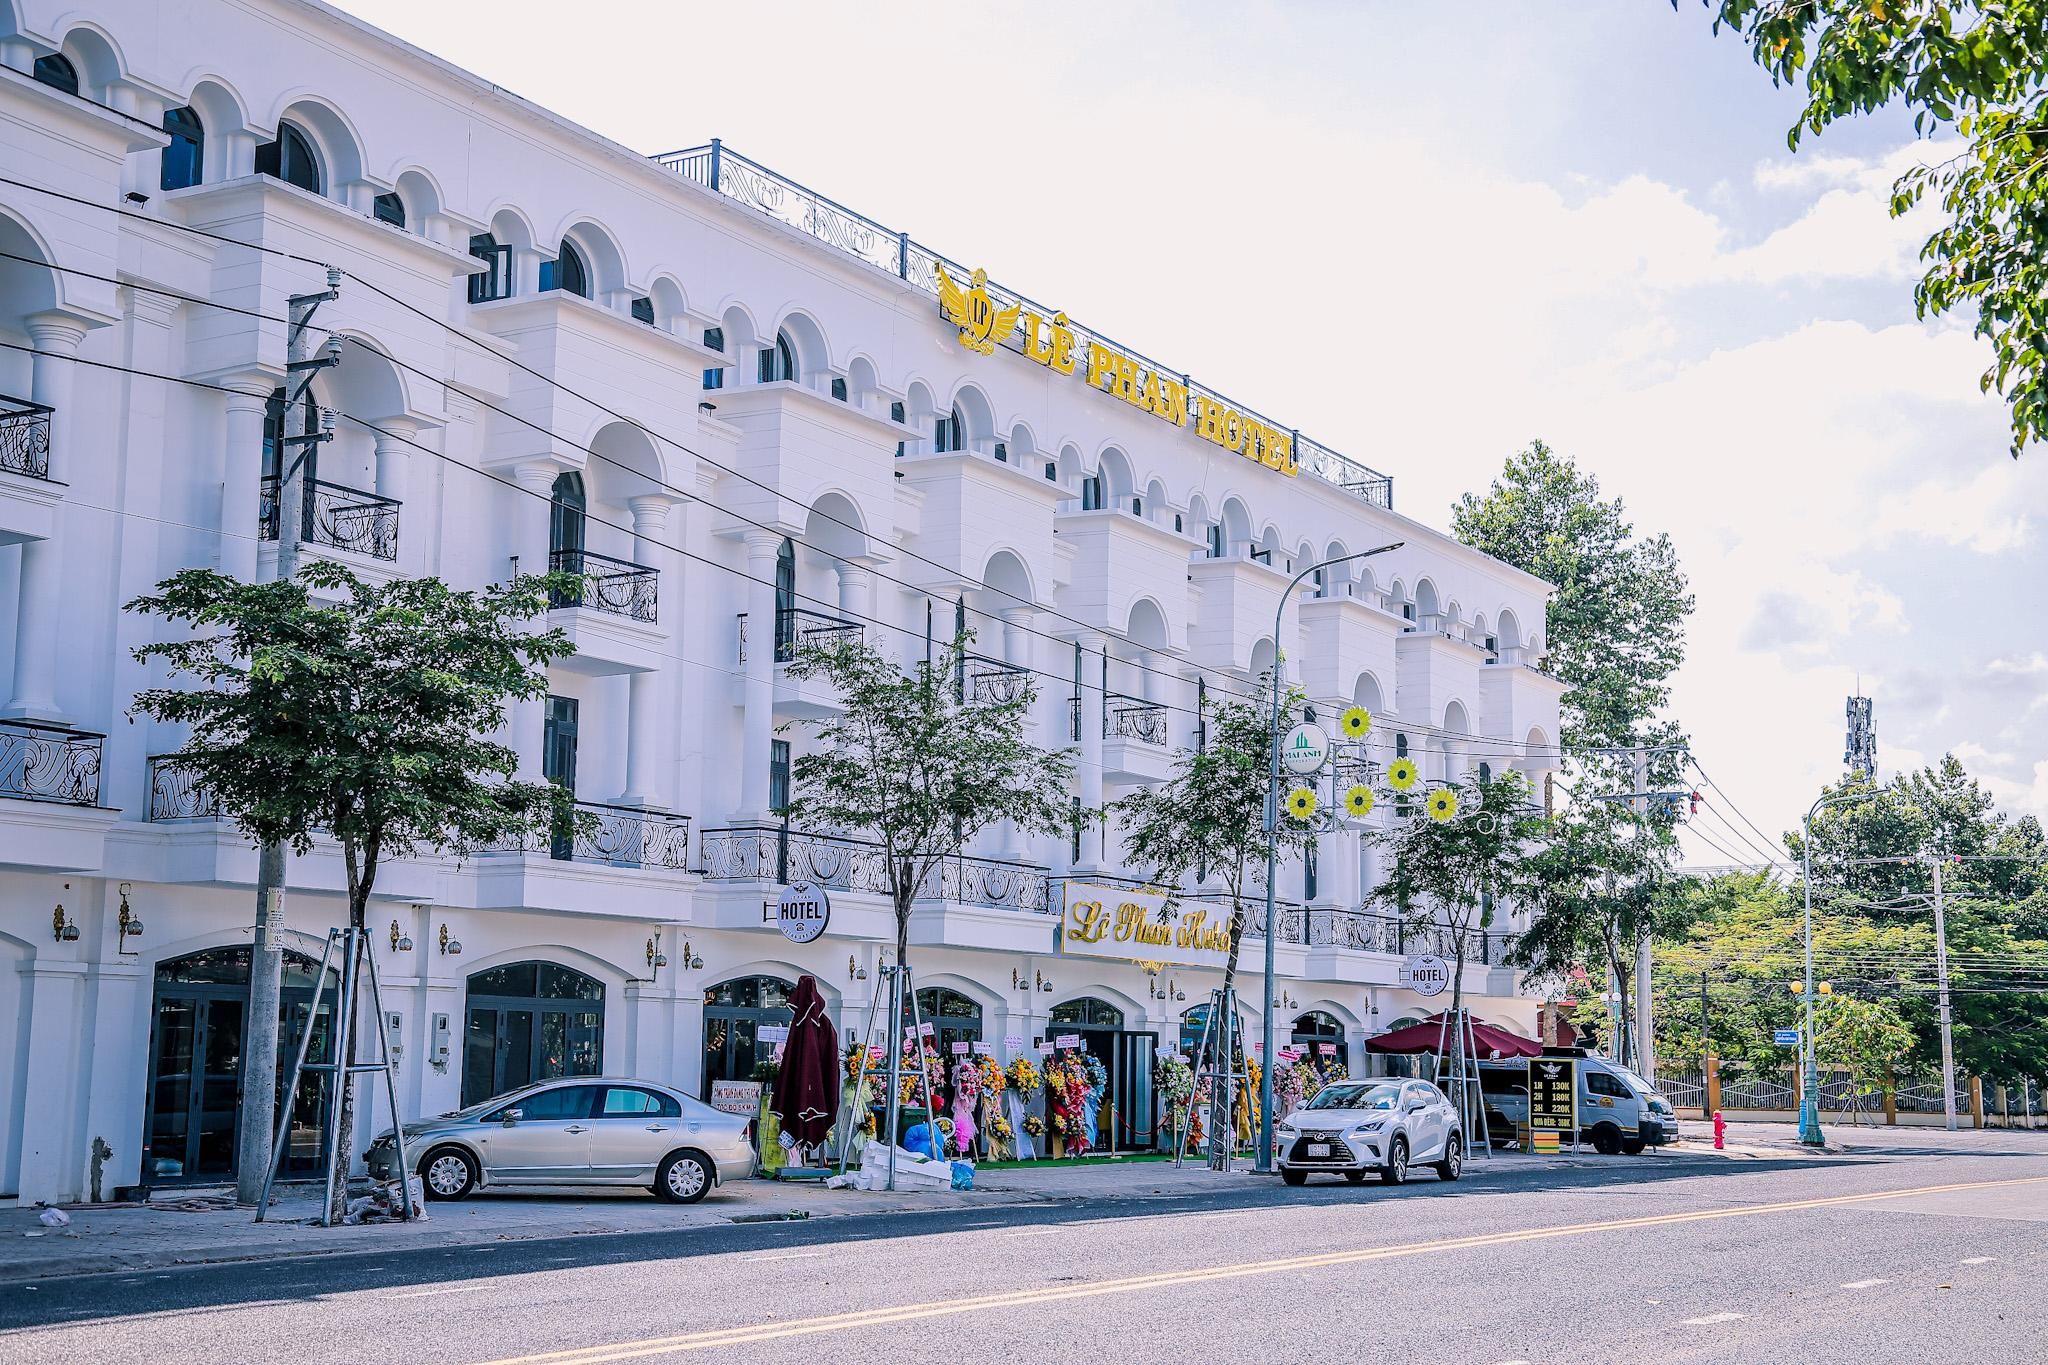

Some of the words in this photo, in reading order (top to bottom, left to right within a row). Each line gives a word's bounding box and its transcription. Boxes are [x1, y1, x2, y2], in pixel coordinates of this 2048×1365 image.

[1023, 310, 1076, 376] LÊ
[1086, 341, 1190, 427] PHAN
[1196, 394, 1299, 478] HOTEL
[781, 901, 822, 920] HOTEL
[1114, 902, 1173, 946] Phan
[1176, 909, 1233, 952] Hotel
[1413, 969, 1445, 982] HOTEL
[1534, 1082, 1543, 1090] 1H
[1552, 1082, 1570, 1091] 130K
[1534, 1093, 1543, 1101] 2H
[1552, 1093, 1570, 1102] 180K
[1534, 1104, 1543, 1112] 3H
[1552, 1105, 1570, 1113] 220K
